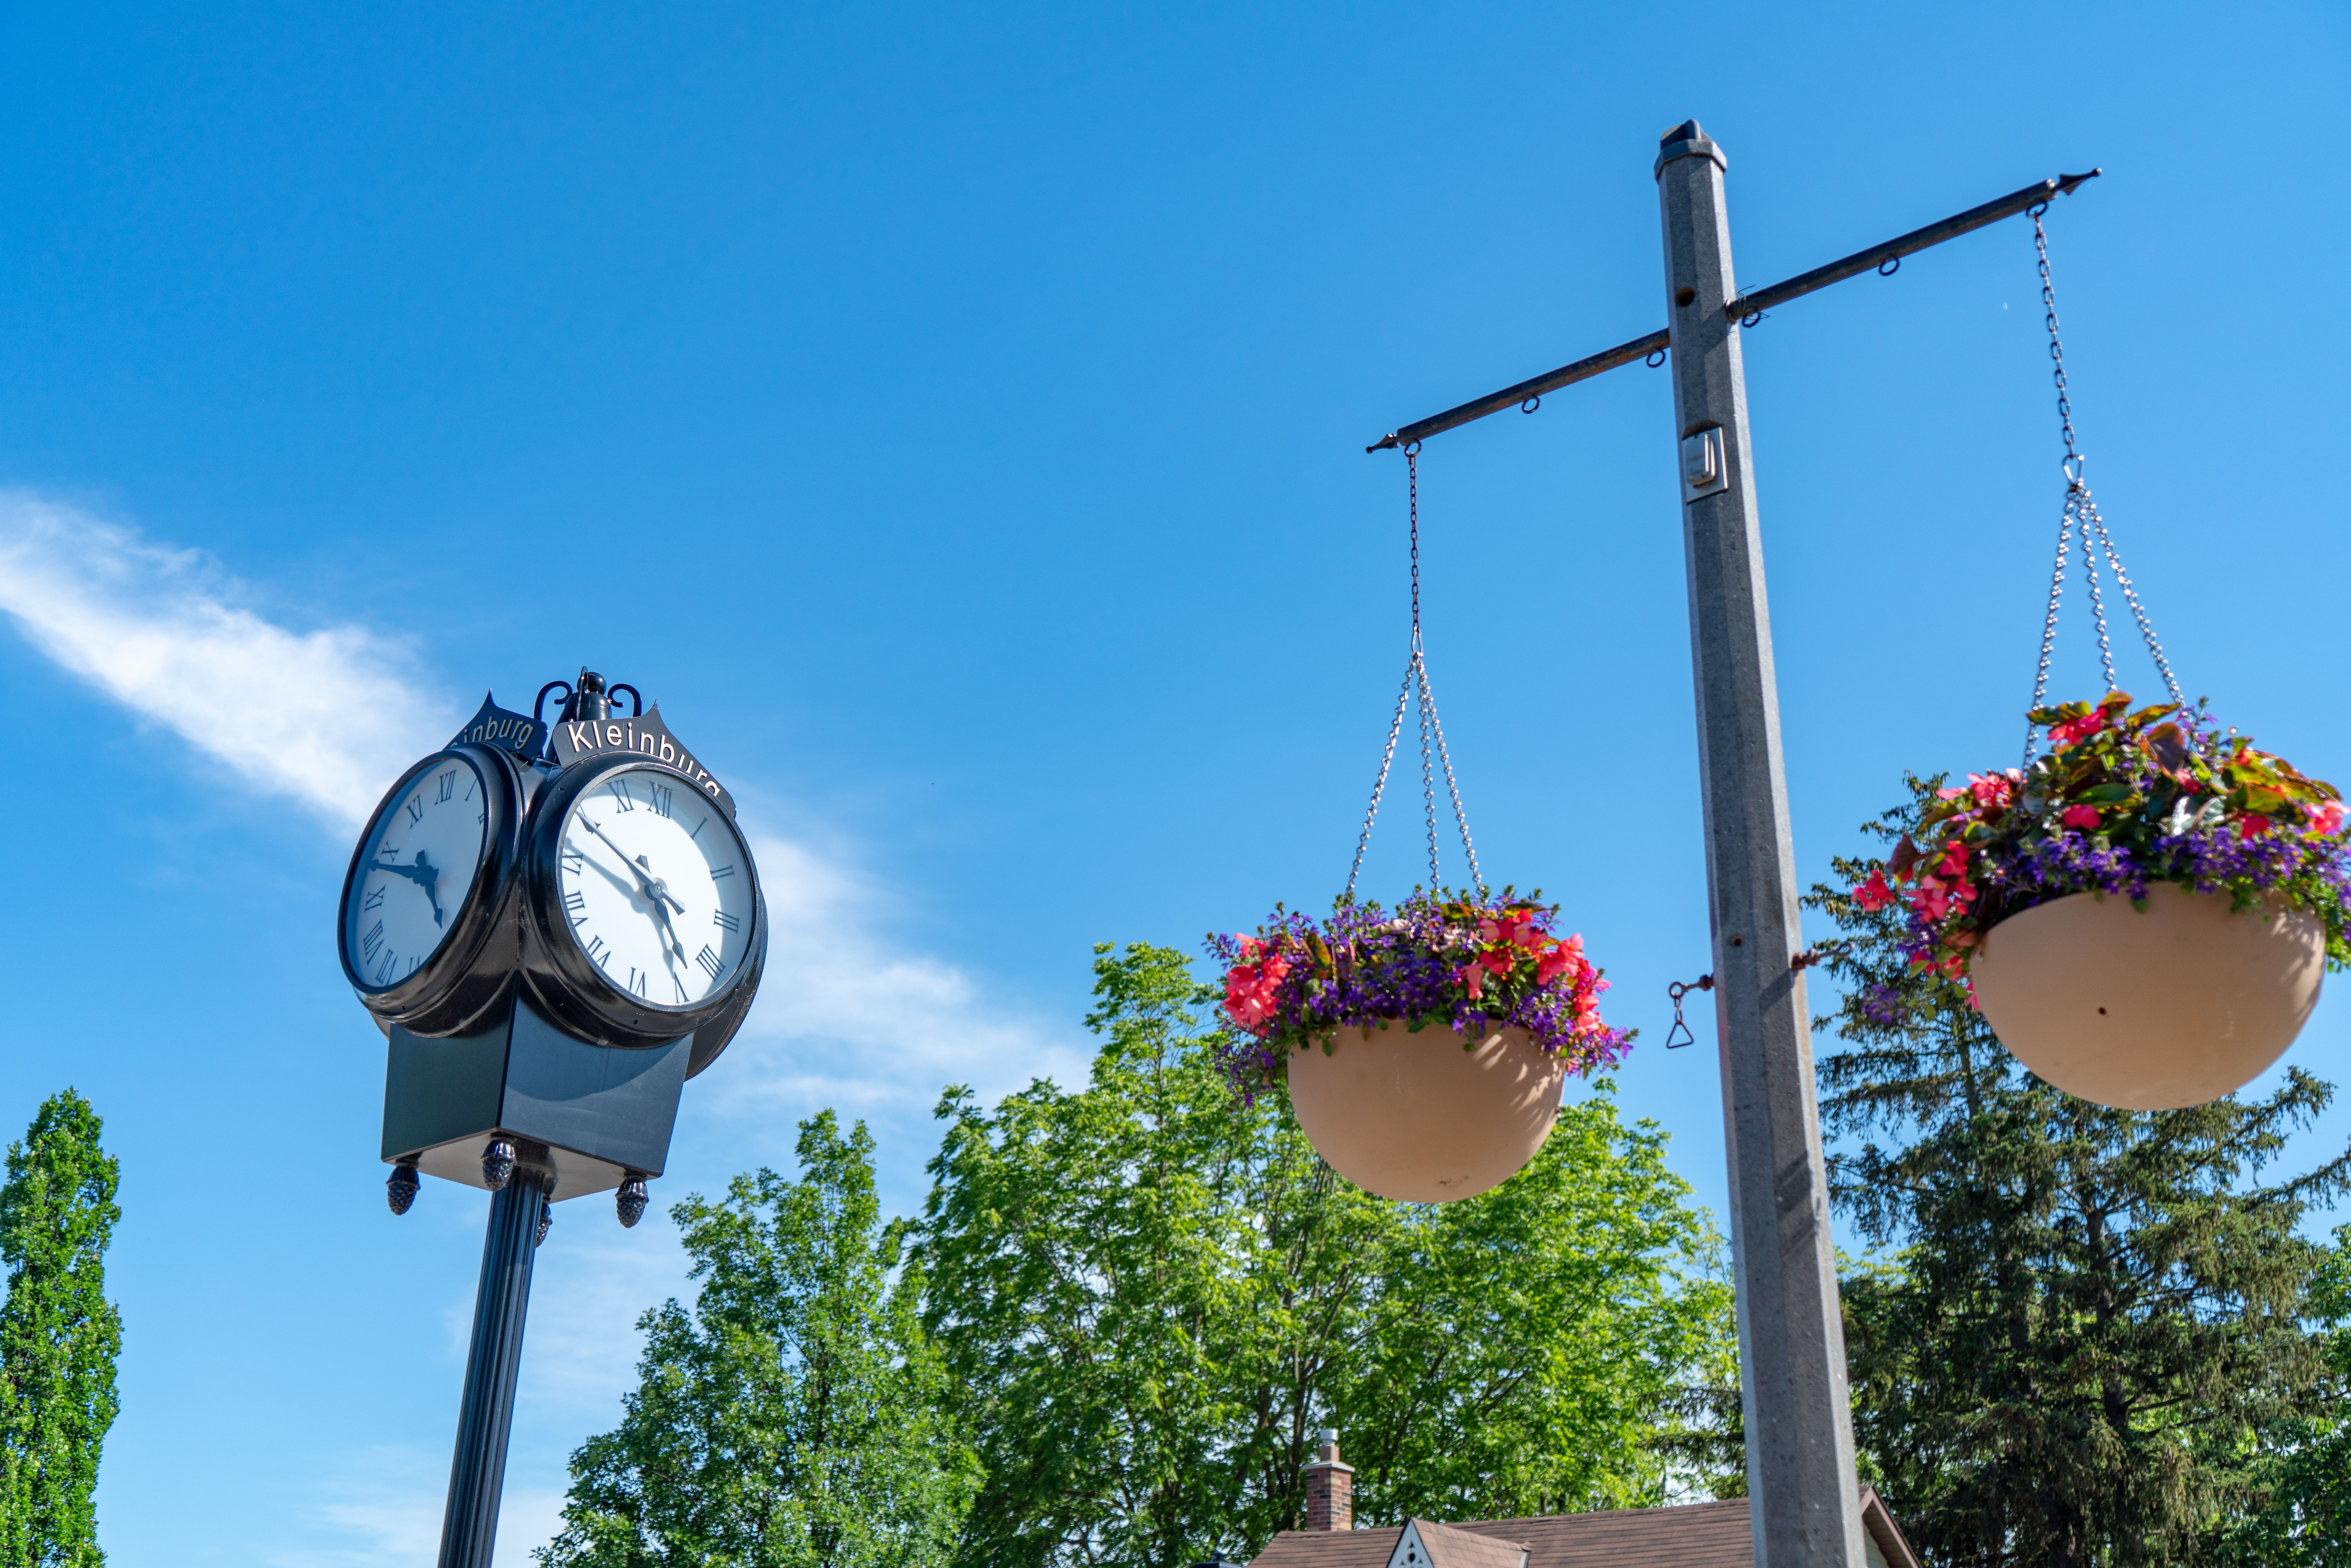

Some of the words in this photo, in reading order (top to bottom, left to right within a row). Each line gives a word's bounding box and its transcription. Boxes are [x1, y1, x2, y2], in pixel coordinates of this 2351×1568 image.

[450, 716, 534, 749] inburg
[406, 793, 423, 829] XI
[606, 779, 634, 814] XI
[646, 780, 675, 819] XII
[381, 840, 399, 863] X
[709, 864, 735, 881] II
[364, 884, 385, 912] IX
[714, 908, 739, 935] III
[363, 919, 384, 966] VIII
